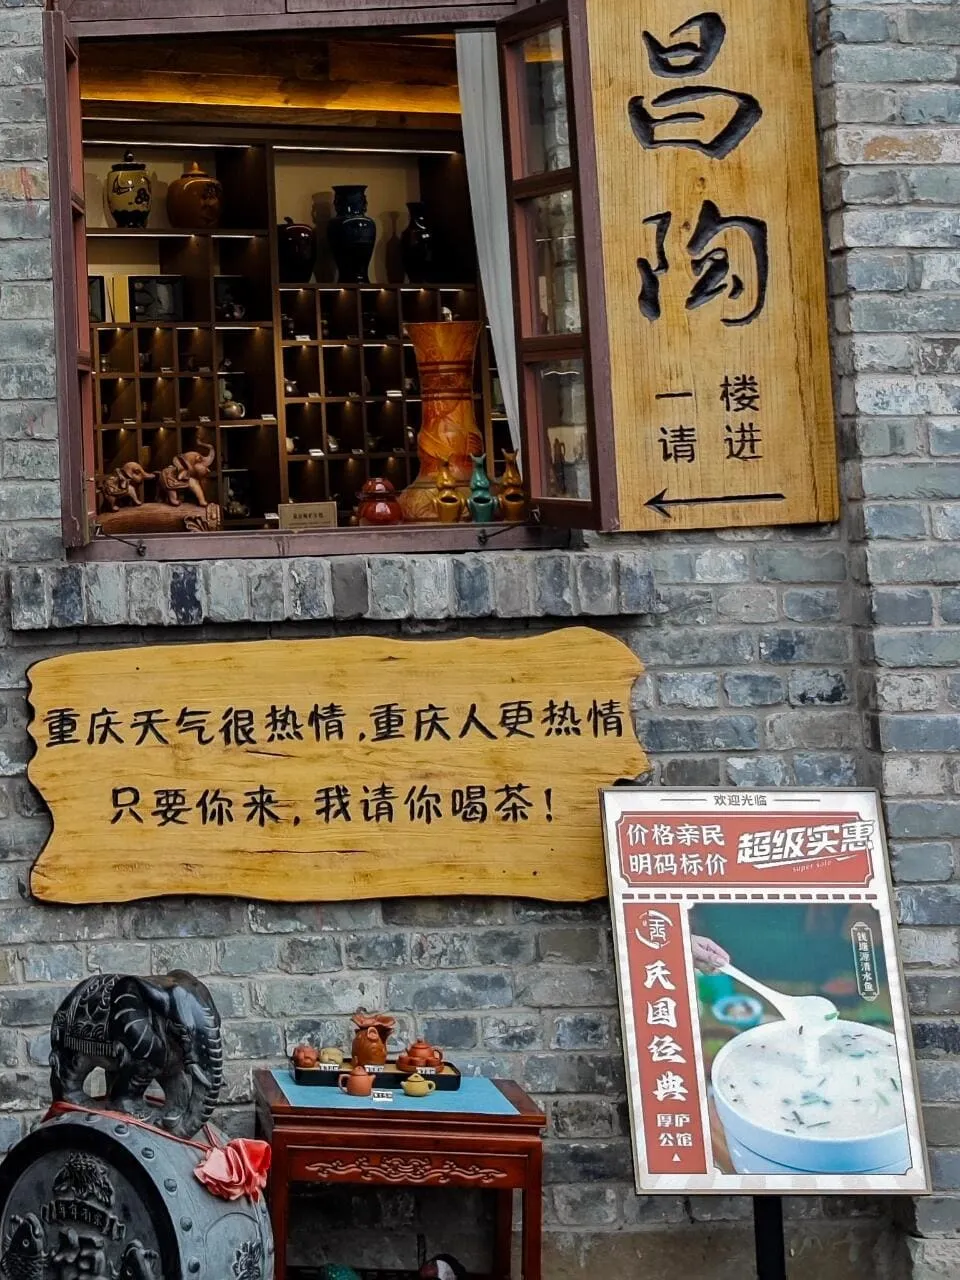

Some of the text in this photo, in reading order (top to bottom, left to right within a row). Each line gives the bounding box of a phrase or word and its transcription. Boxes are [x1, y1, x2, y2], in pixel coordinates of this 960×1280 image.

[654, 374, 761, 414] 一楼
[657, 423, 764, 464] 请进
[713, 794, 768, 807] 欢迎光临
[626, 823, 725, 847] 价格亲民
[736, 819, 875, 865] 超级实惠
[629, 853, 728, 877] 明码标价
[643, 960, 690, 1103] 民国经典
[659, 1131, 693, 1148] 公馆
